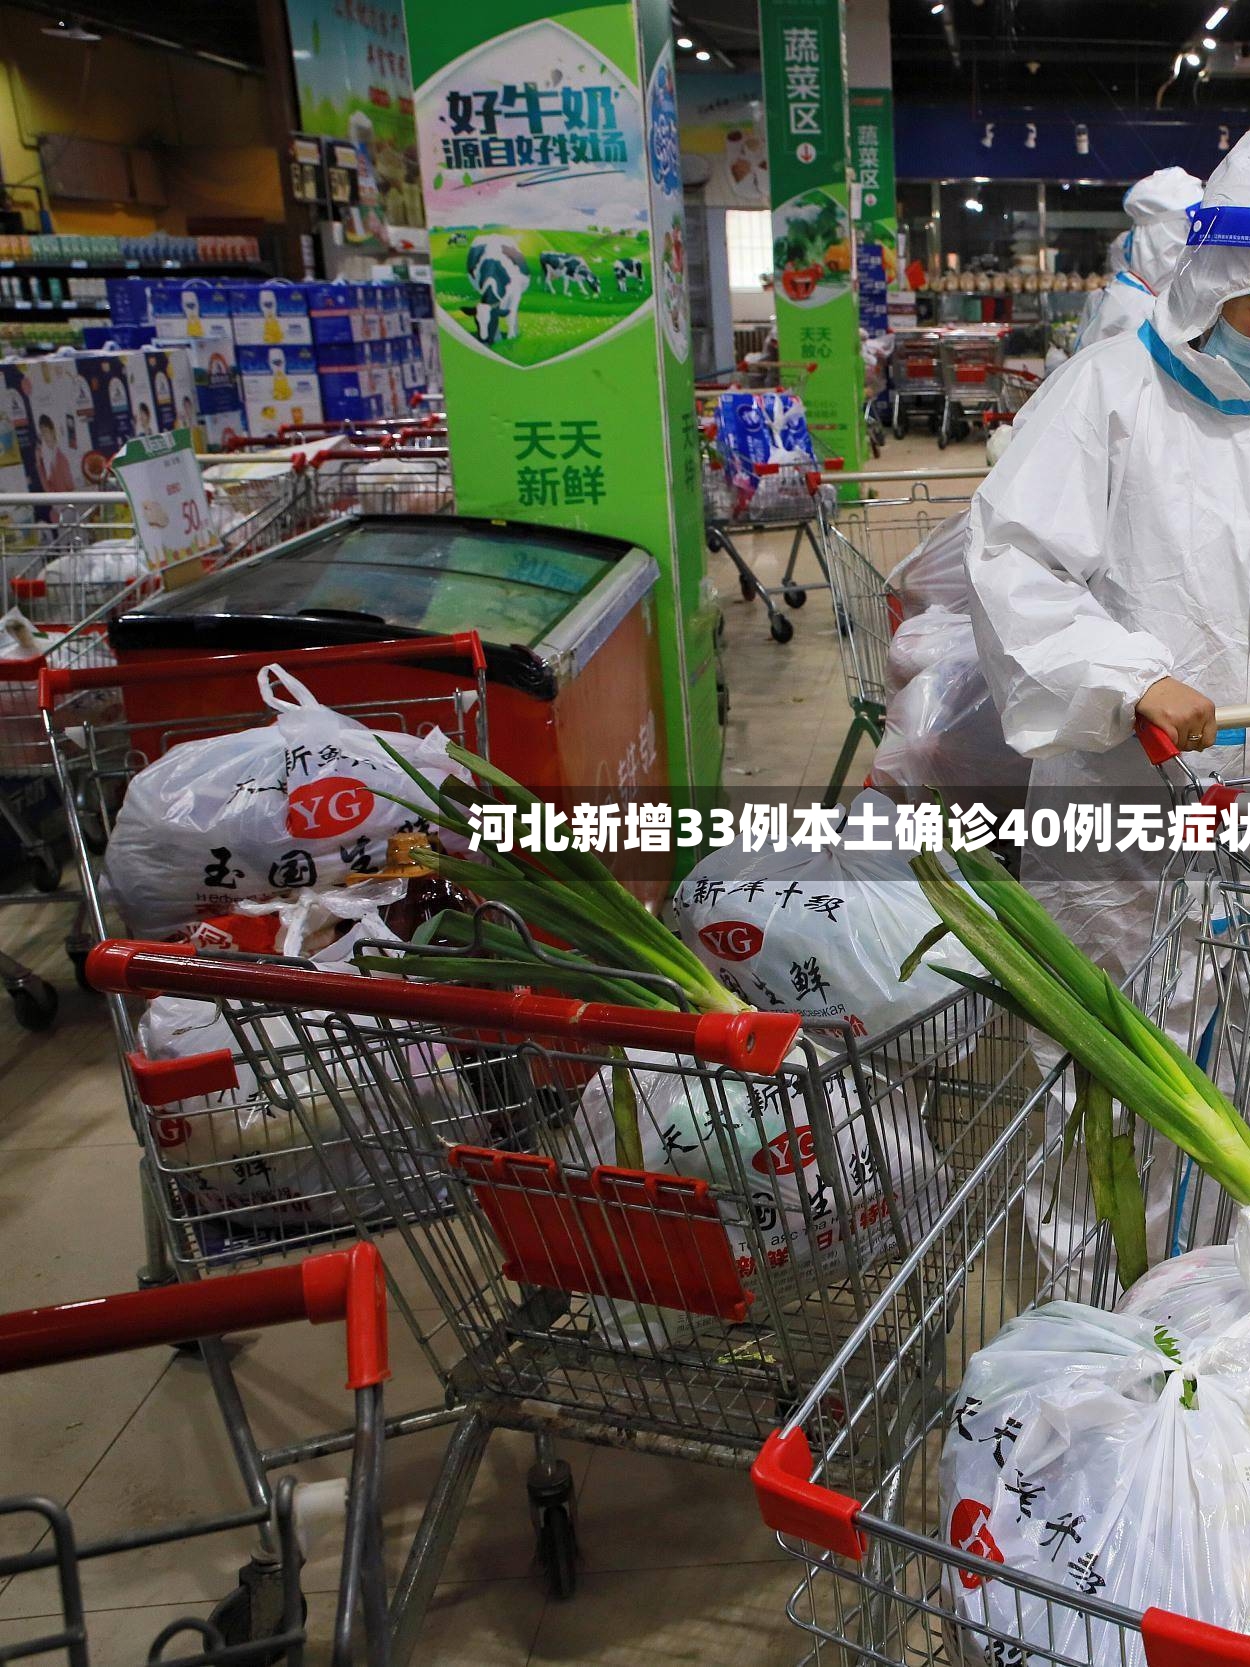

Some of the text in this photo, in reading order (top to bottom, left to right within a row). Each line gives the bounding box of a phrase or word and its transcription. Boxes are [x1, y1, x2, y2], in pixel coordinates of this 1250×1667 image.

[783, 27, 822, 134] 蔬菜区
[446, 82, 618, 136] 好牛奶
[441, 131, 628, 170] 源自好牧场
[856, 124, 881, 190] 蔬菜区
[513, 420, 602, 460] 天天
[517, 465, 606, 506] 新鲜
[290, 788, 361, 832] YG
[703, 927, 753, 955] YG
